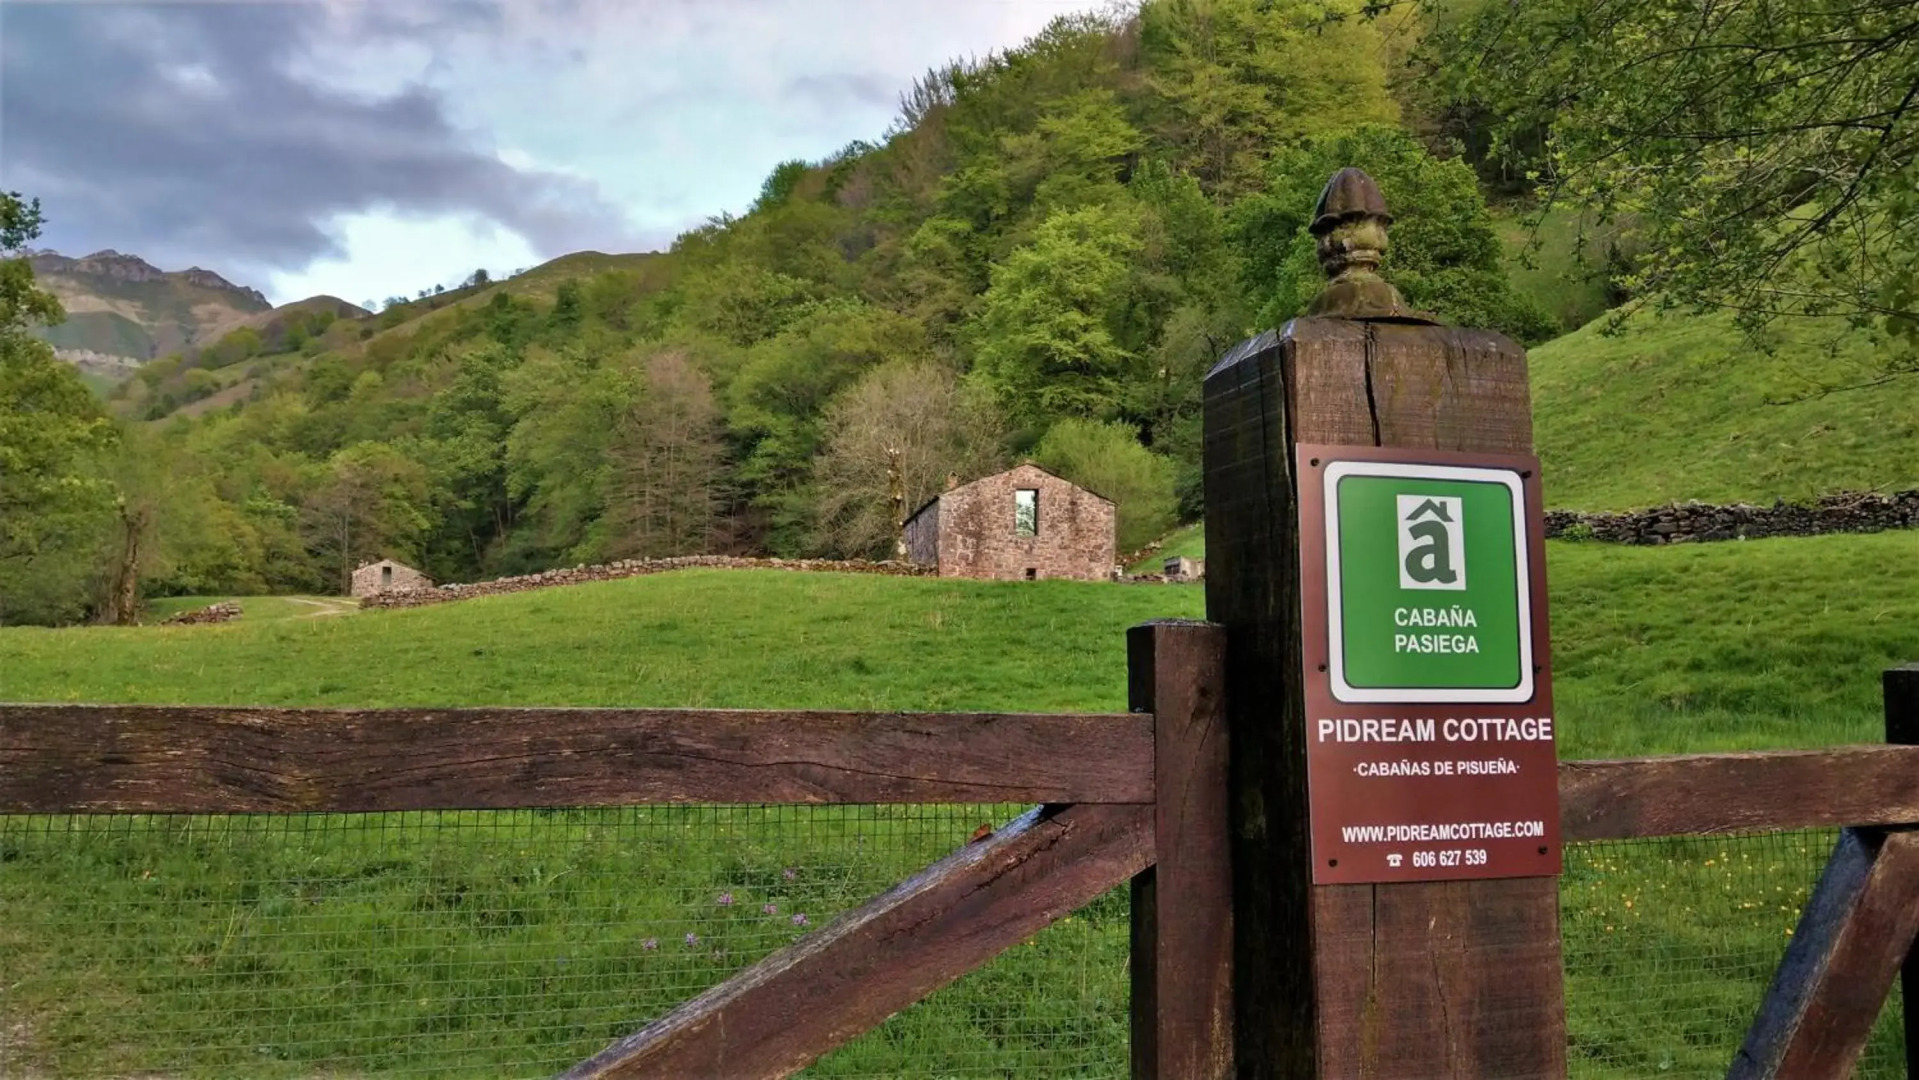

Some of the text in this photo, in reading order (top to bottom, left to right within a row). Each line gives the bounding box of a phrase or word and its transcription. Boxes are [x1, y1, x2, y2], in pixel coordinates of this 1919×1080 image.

[1394, 605, 1478, 628] CABAÑA
[1394, 634, 1480, 654] PASIEGA
[1317, 718, 1553, 743] PIDREAM COTTAGE
[1434, 761, 1454, 776] DE
[1342, 821, 1544, 843] WWW.PIDREAMCOTTAGE.COM
[1412, 849, 1487, 868] 606 627 539
